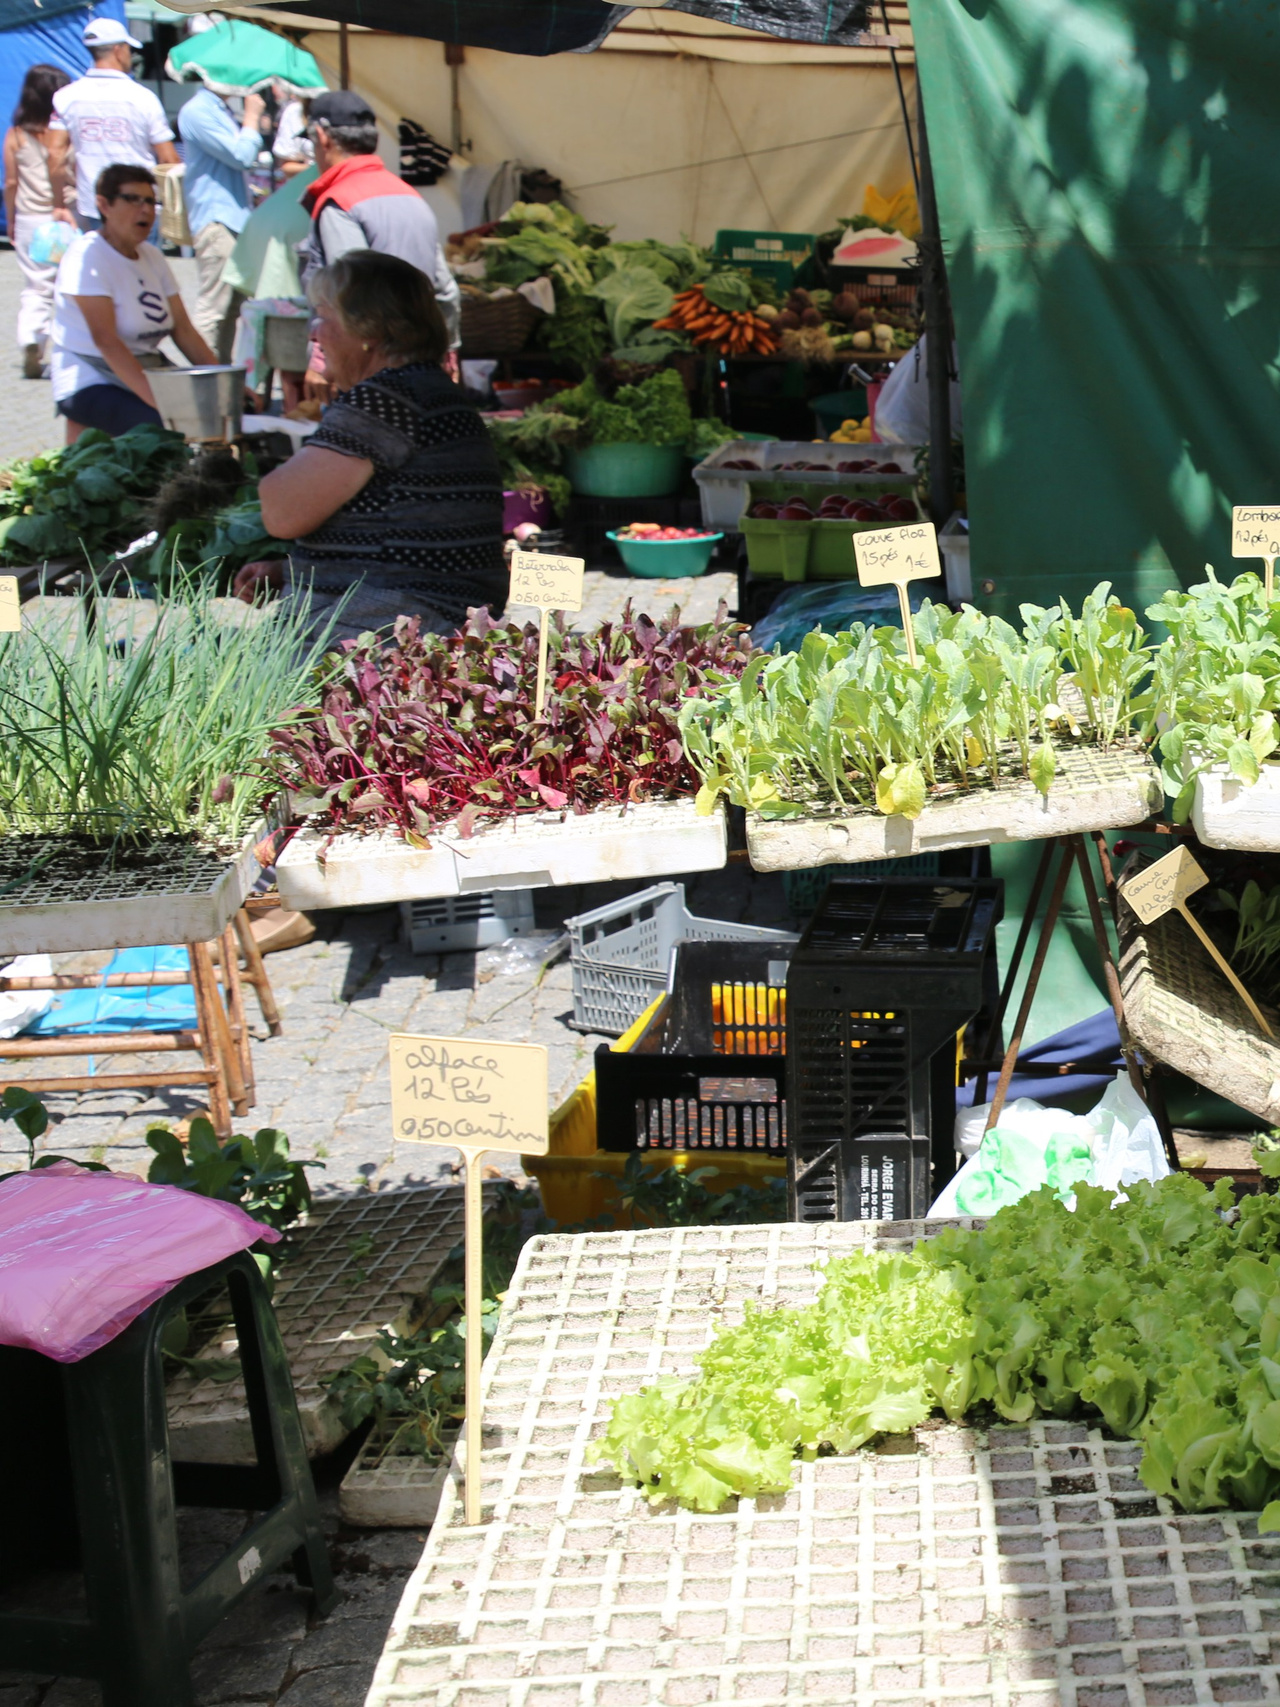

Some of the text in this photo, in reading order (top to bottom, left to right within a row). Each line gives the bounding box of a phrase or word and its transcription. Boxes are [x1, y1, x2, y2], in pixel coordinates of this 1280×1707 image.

[78, 116, 131, 142] 53
[515, 573, 530, 585] 12
[404, 1075, 446, 1100] 12
[870, 1169, 879, 1192] SERRA
[881, 1155, 894, 1191] JORGE
[870, 1194, 879, 1205] DO
